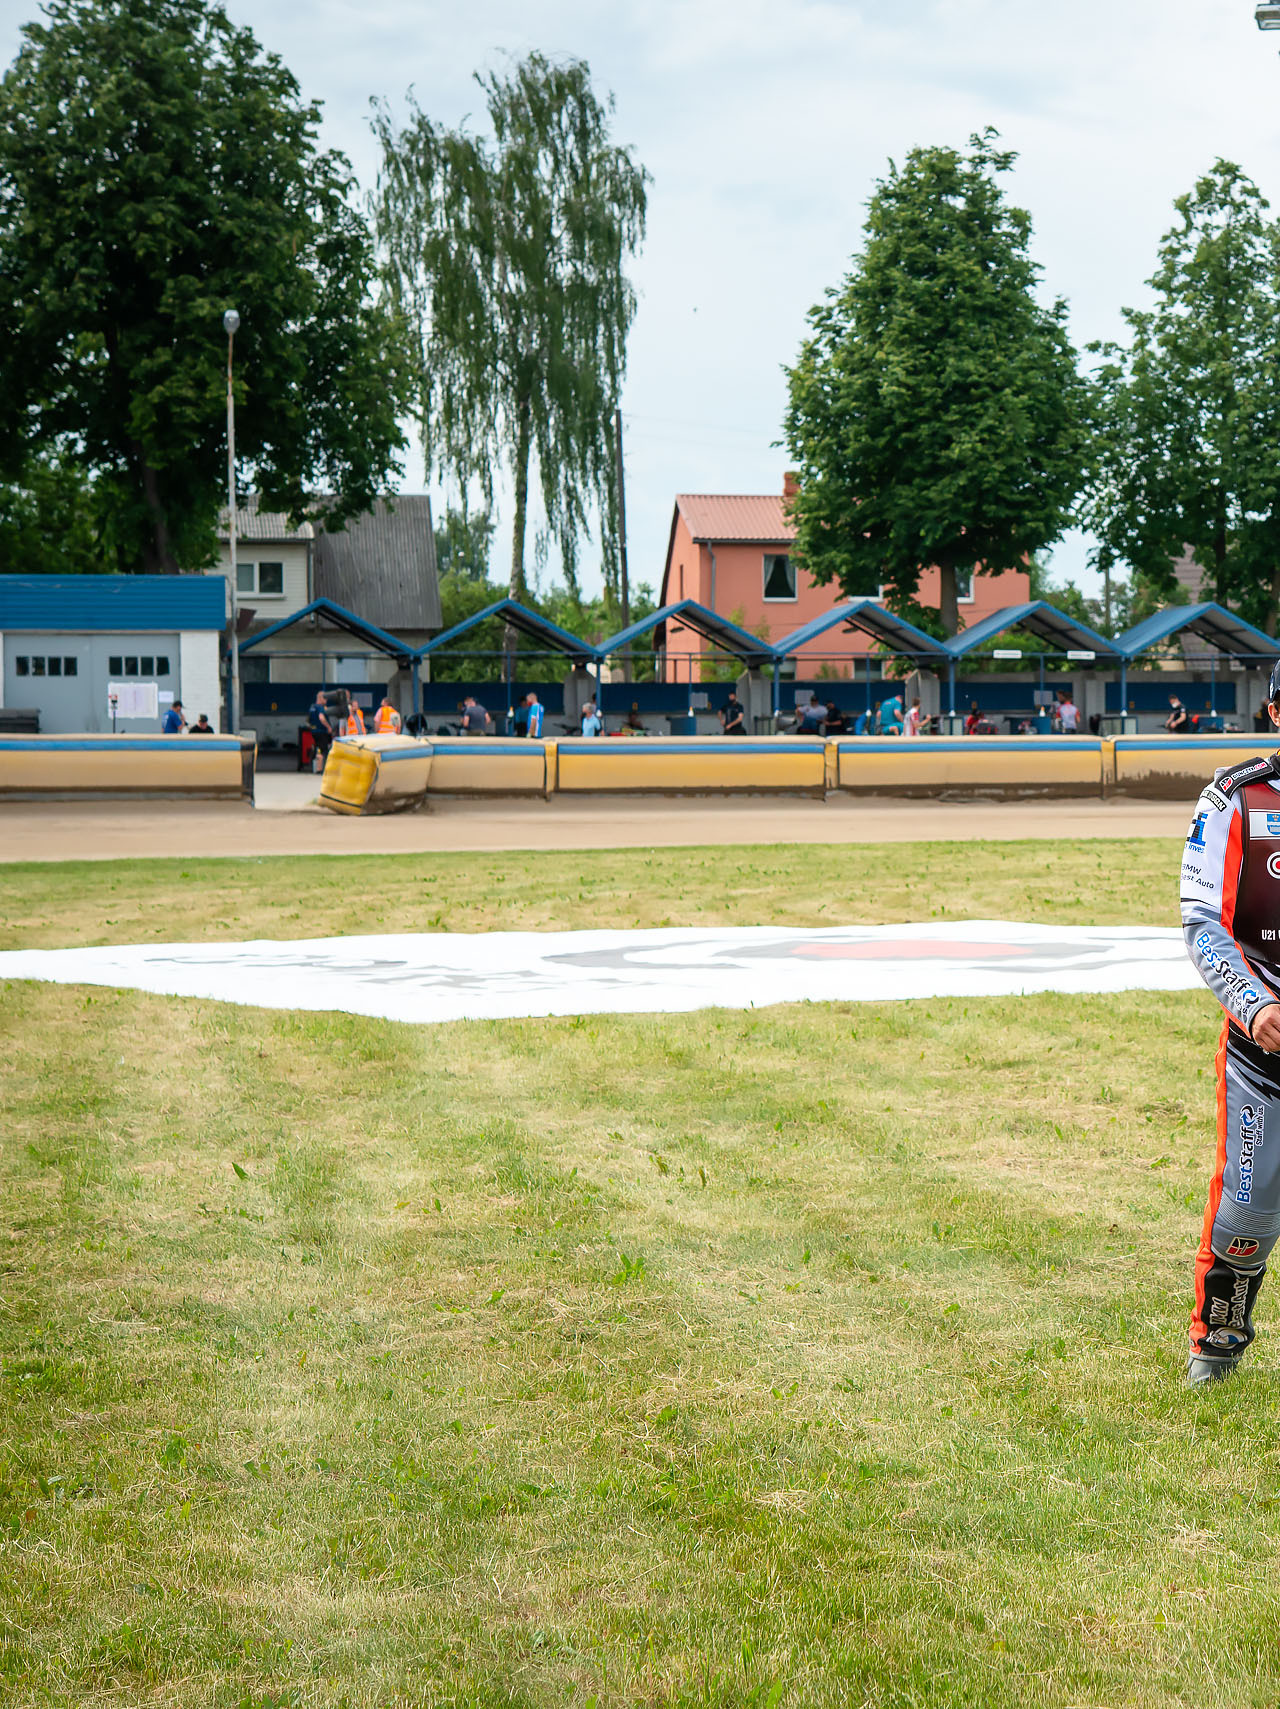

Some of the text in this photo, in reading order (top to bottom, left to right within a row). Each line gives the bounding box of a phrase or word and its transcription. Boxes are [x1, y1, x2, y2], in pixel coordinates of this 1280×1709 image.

[1196, 878, 1215, 889] Auto
[1261, 930, 1276, 941] U21
[1256, 1115, 1264, 1130] with
[1237, 1126, 1254, 1203] BestStaff
